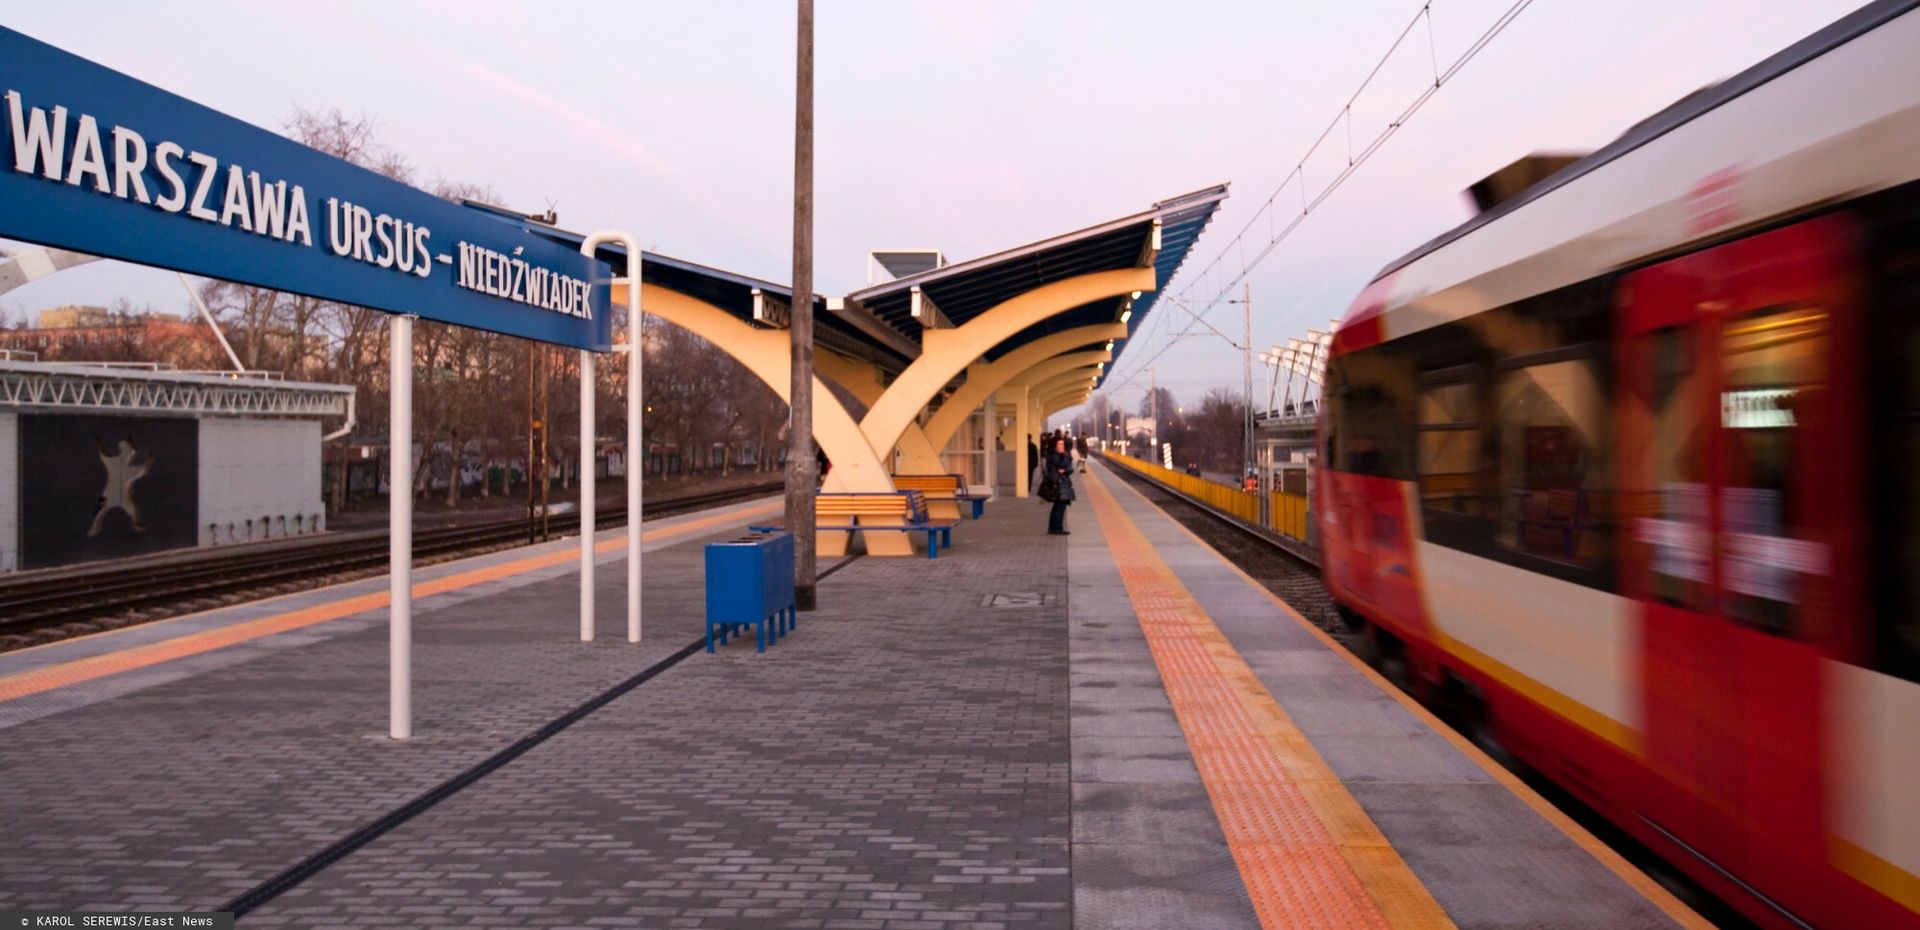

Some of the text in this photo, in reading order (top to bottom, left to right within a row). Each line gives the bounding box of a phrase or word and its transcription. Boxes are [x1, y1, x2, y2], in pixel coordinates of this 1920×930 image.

[6, 89, 312, 247] WARSZAWA
[328, 197, 431, 278] URSUS
[457, 240, 593, 320] NIEDŹWIADEK
